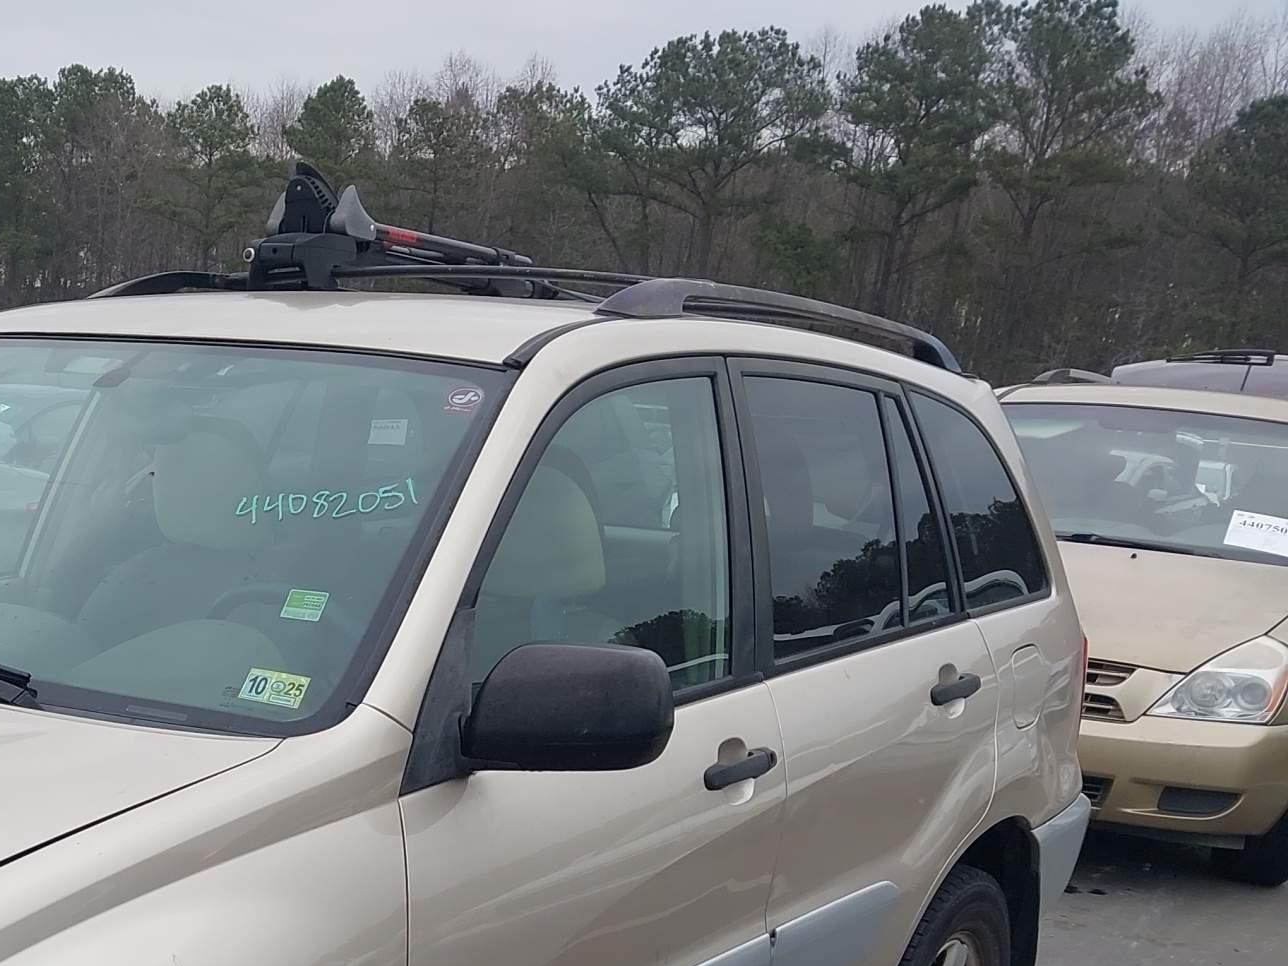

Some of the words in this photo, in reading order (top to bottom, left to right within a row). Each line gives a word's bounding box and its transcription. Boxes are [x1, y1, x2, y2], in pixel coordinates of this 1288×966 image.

[235, 477, 418, 524] 44082051
[248, 675, 268, 695] 10
[284, 682, 305, 697] 25
